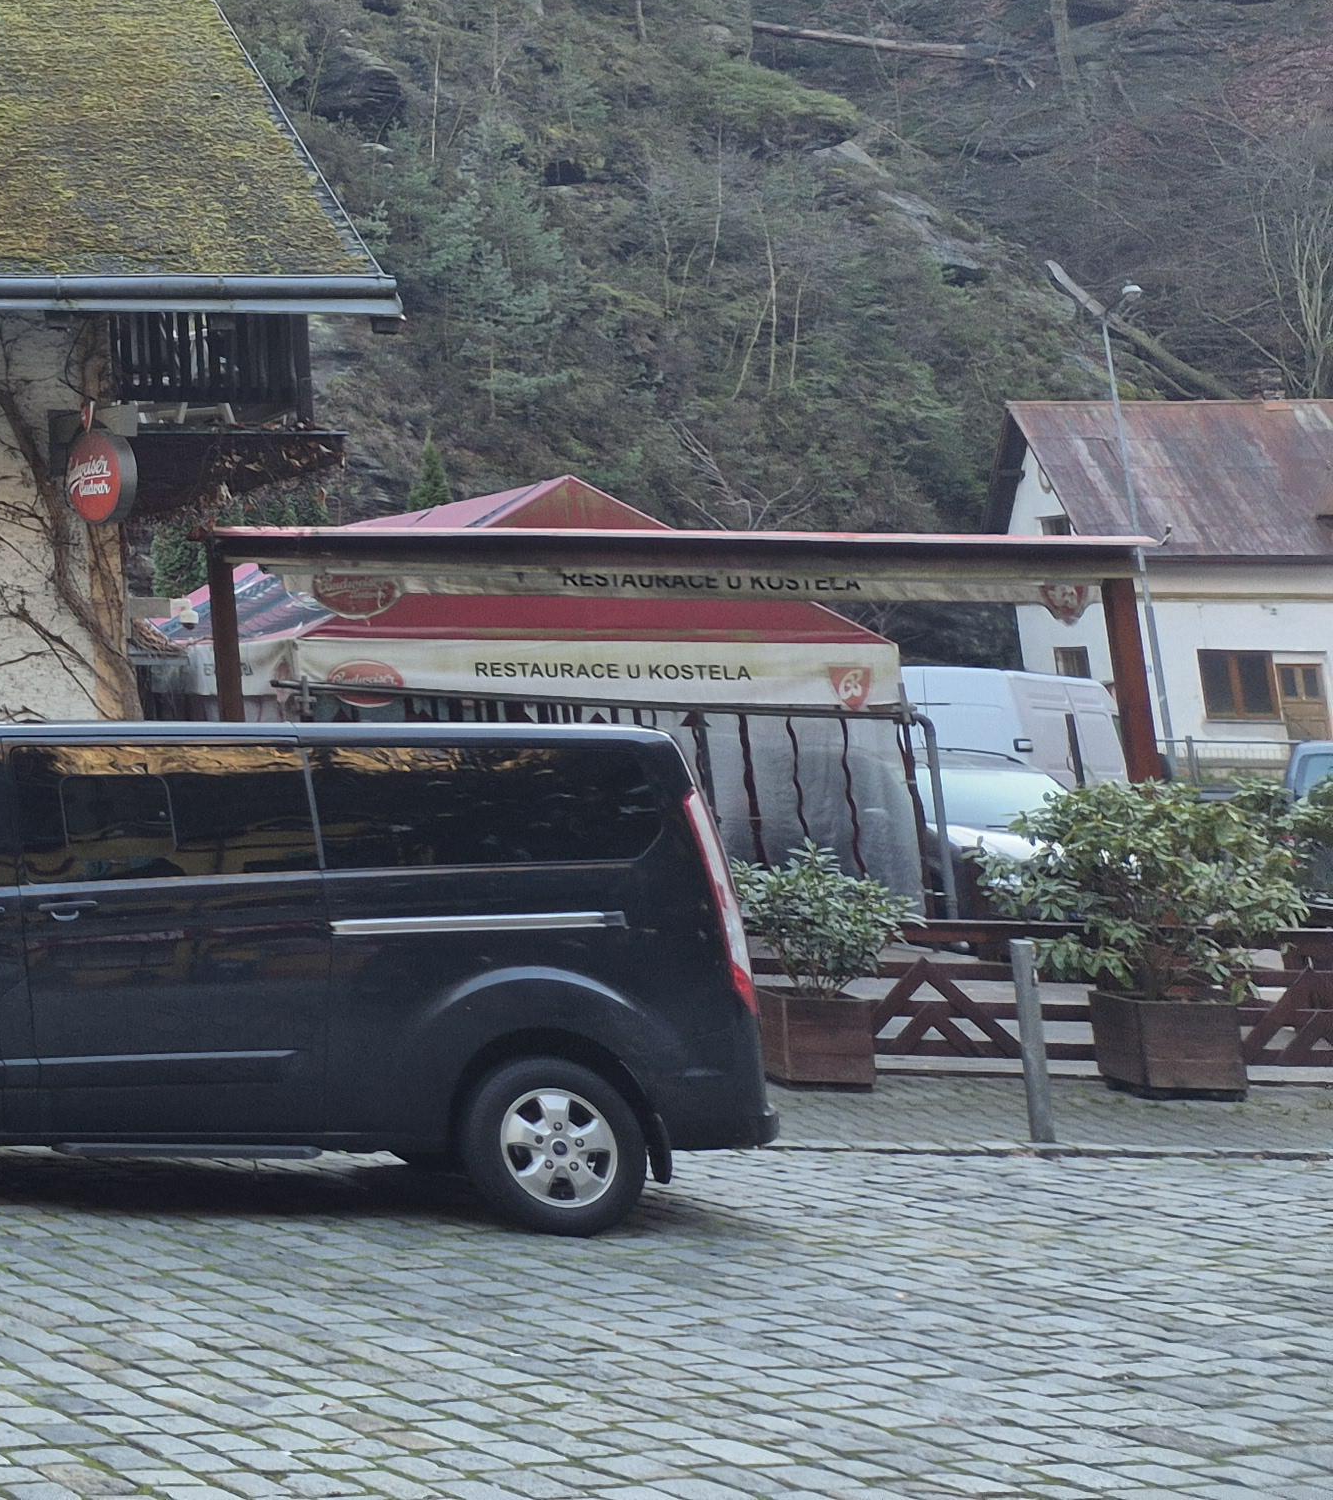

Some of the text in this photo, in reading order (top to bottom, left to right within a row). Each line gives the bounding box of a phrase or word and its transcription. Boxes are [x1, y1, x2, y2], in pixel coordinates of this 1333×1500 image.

[475, 662, 752, 681] RESTAURACE U KOSTELA
